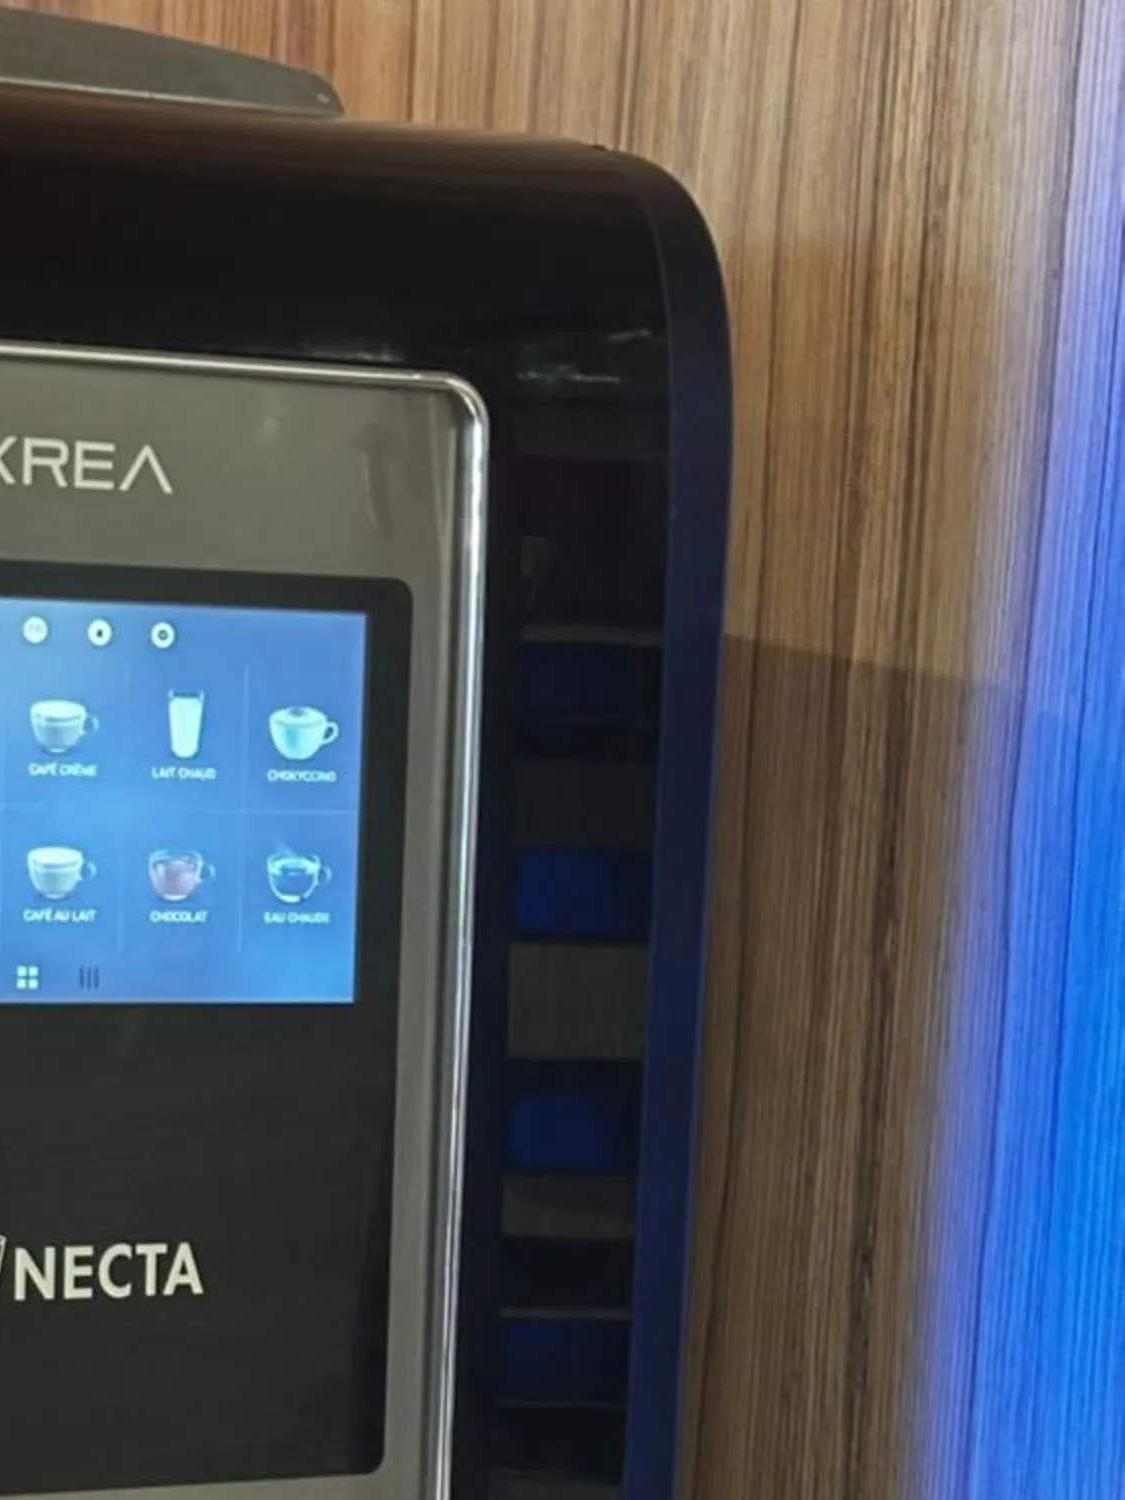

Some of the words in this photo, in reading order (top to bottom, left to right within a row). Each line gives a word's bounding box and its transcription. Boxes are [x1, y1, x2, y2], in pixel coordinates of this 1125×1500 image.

[28, 761, 57, 776] CAFÉ
[151, 767, 176, 780] LAIT
[178, 767, 217, 781] CHAUD
[24, 907, 52, 922] CAFÉ
[53, 909, 70, 922] AU
[72, 909, 96, 922] LAIT
[149, 910, 208, 923] CHOCOLAT
[264, 911, 286, 924] EAU
[287, 911, 330, 924] CHAUDE
[14, 1242, 204, 1301] NECTA
